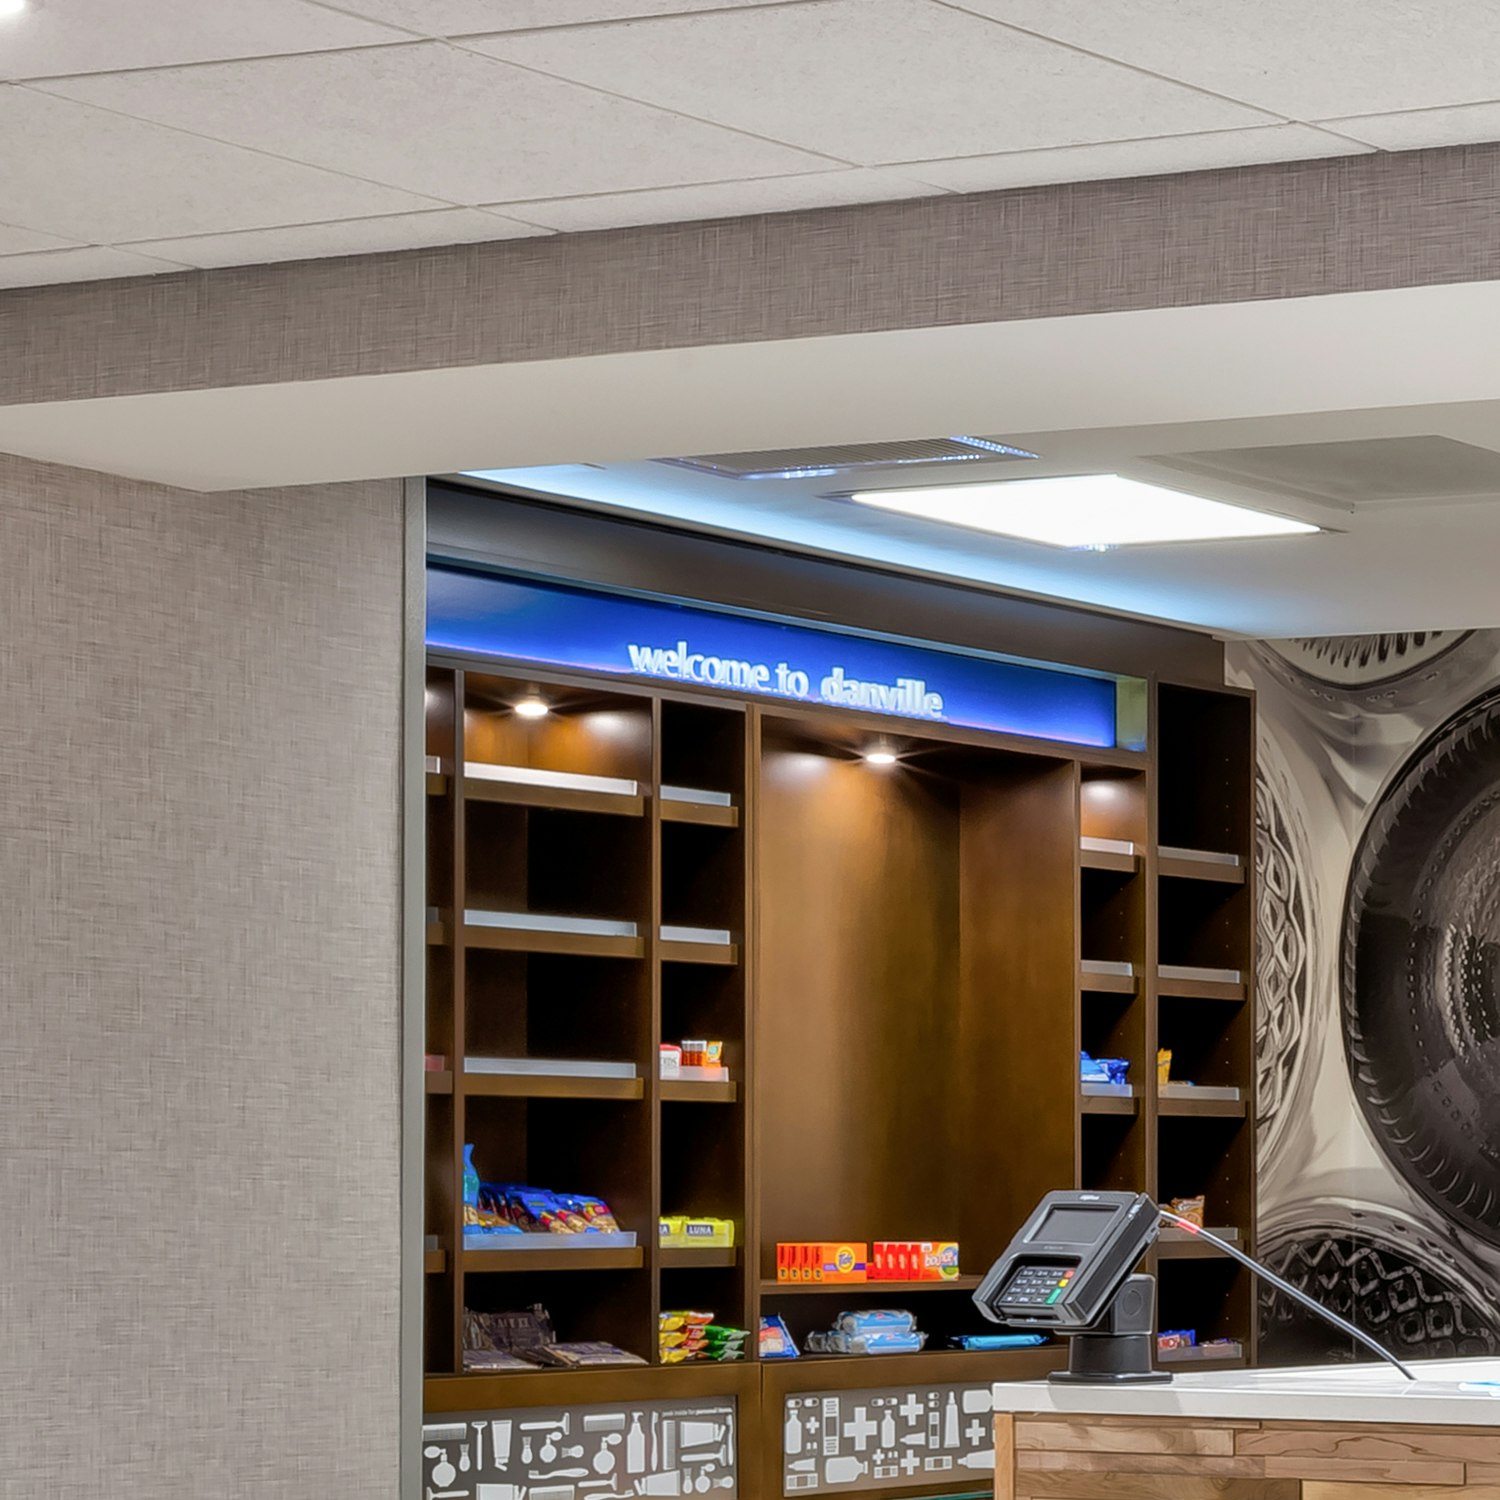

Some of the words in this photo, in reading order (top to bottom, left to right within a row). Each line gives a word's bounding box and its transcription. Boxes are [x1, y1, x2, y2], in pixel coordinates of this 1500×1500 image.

[628, 641, 770, 689] welcome
[775, 663, 809, 698] to
[820, 667, 944, 717] danville
[688, 1225, 712, 1235] LUNA
